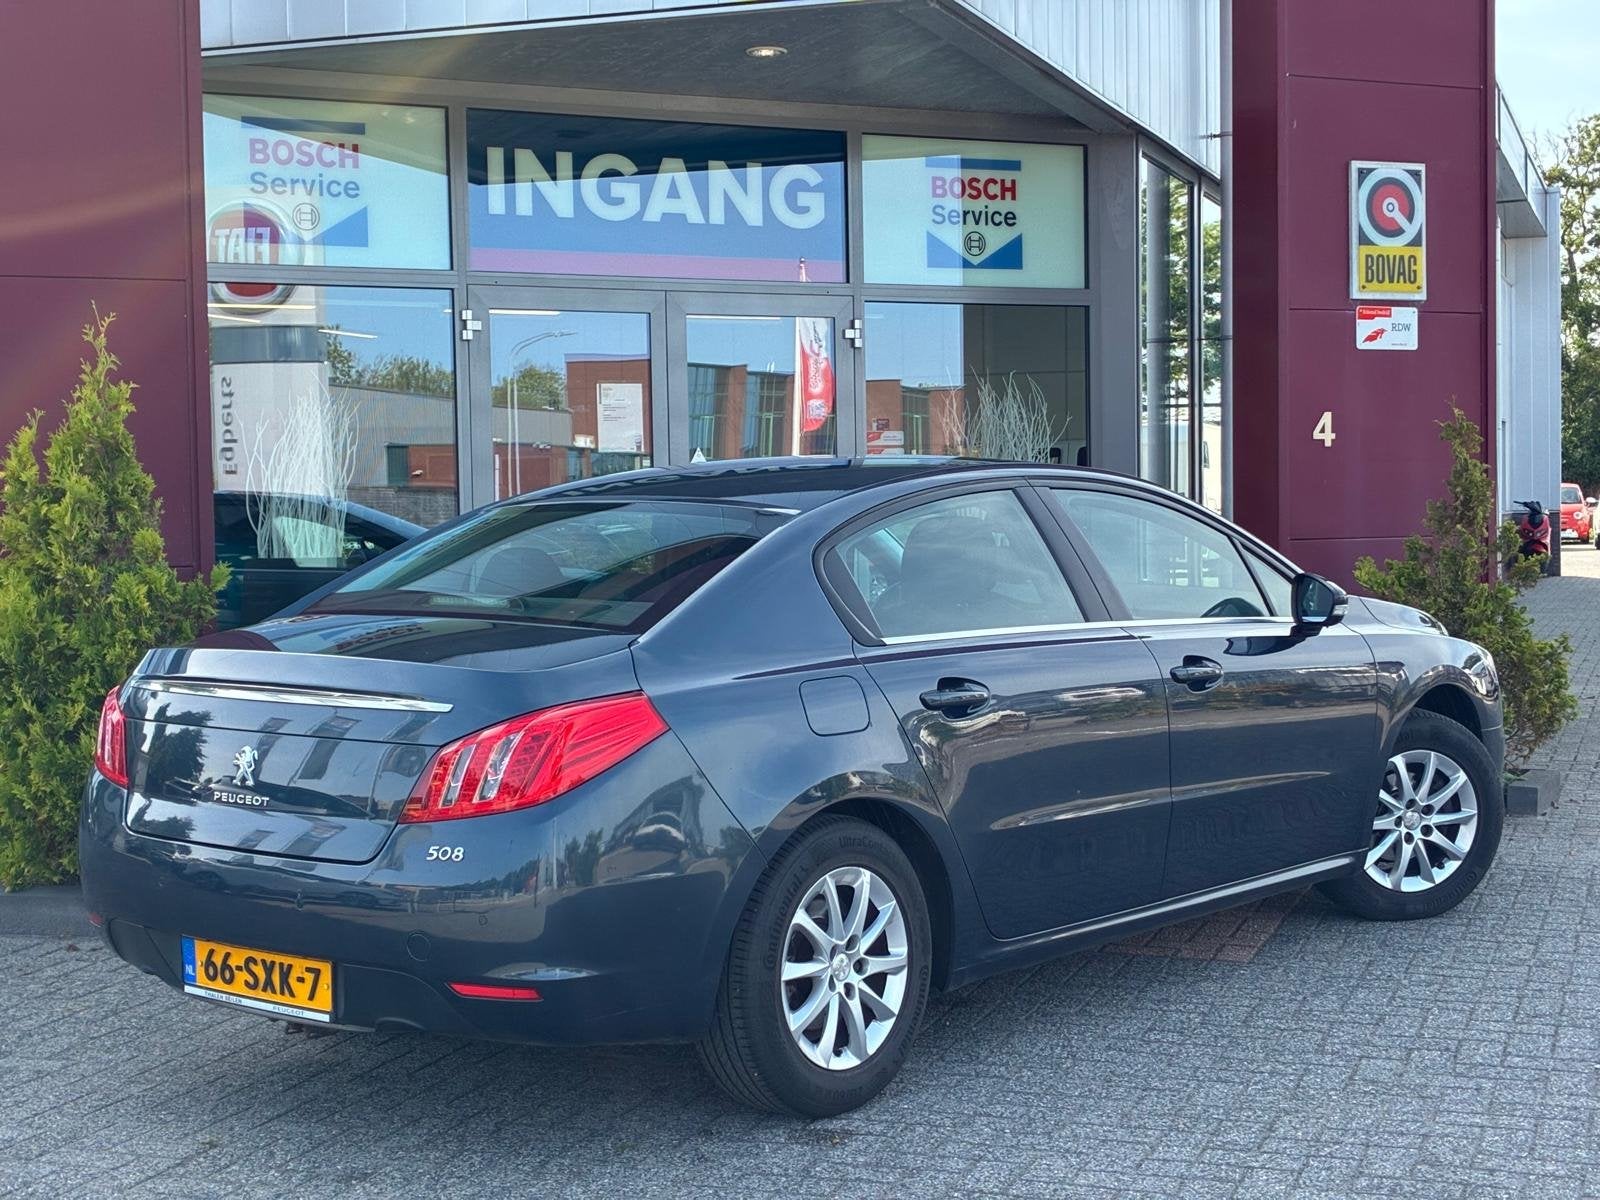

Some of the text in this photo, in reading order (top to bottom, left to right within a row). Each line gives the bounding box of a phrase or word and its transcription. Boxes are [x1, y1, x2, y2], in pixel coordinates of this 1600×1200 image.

[249, 138, 360, 169] BOSCH
[250, 171, 361, 199] Service
[486, 146, 826, 230] INGANG
[931, 175, 1017, 201] BOSCH
[931, 203, 1017, 228] Service
[1365, 254, 1417, 284] BOVAG
[1391, 322, 1411, 332] RDW
[1312, 411, 1336, 447] 4
[213, 791, 270, 807] PEUGEOT
[426, 845, 465, 862] 508
[185, 963, 195, 976] NL
[203, 948, 322, 1002] 66-SXK-7
